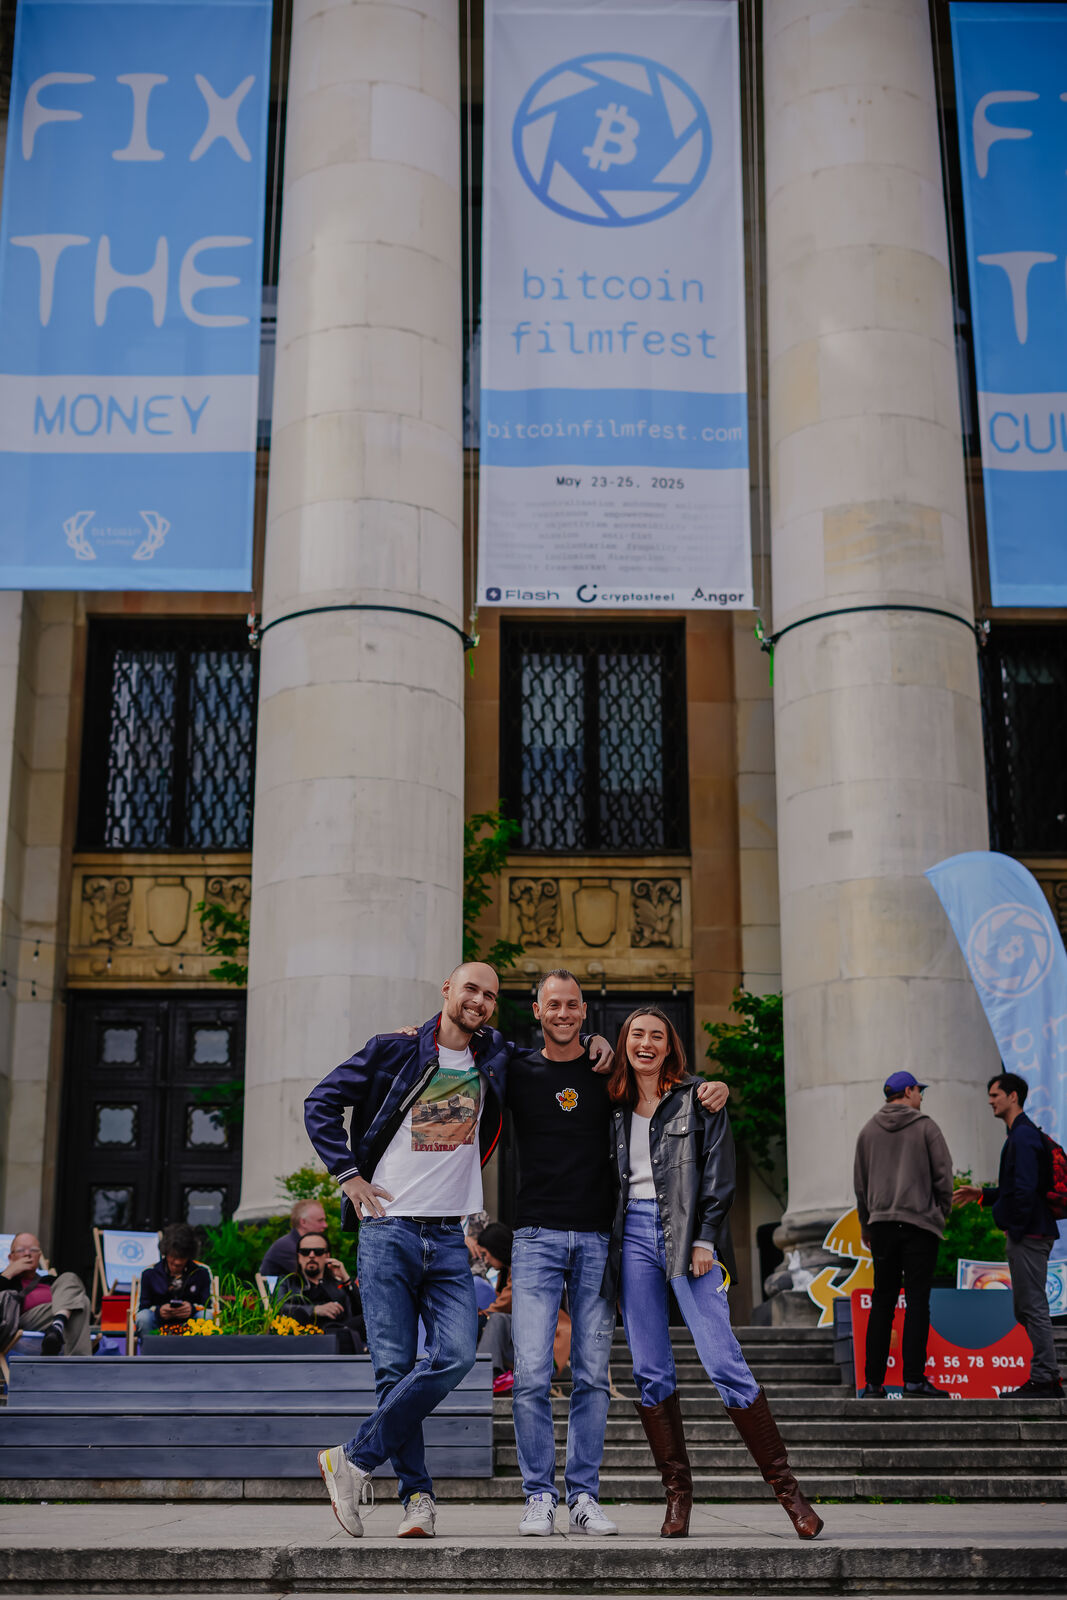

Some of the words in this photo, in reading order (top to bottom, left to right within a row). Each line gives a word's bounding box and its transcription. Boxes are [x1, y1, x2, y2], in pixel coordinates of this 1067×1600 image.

[22, 72, 256, 163] FIX
[973, 91, 1067, 179] F
[9, 233, 254, 328] THE
[522, 268, 705, 303] bitcoin
[977, 252, 1067, 345] T
[511, 321, 717, 359] filmfest
[34, 394, 210, 437] MONEY
[486, 419, 743, 443] bitcoinfilmfest.com
[556, 476, 582, 488] May
[651, 477, 685, 490] 2025
[506, 589, 559, 601] Flash
[601, 591, 675, 603] cryptosteel
[938, 1374, 969, 1384] 12/34
[943, 1355, 960, 1368] 56
[968, 1355, 984, 1368] 78
[991, 1355, 1025, 1368] 9014
